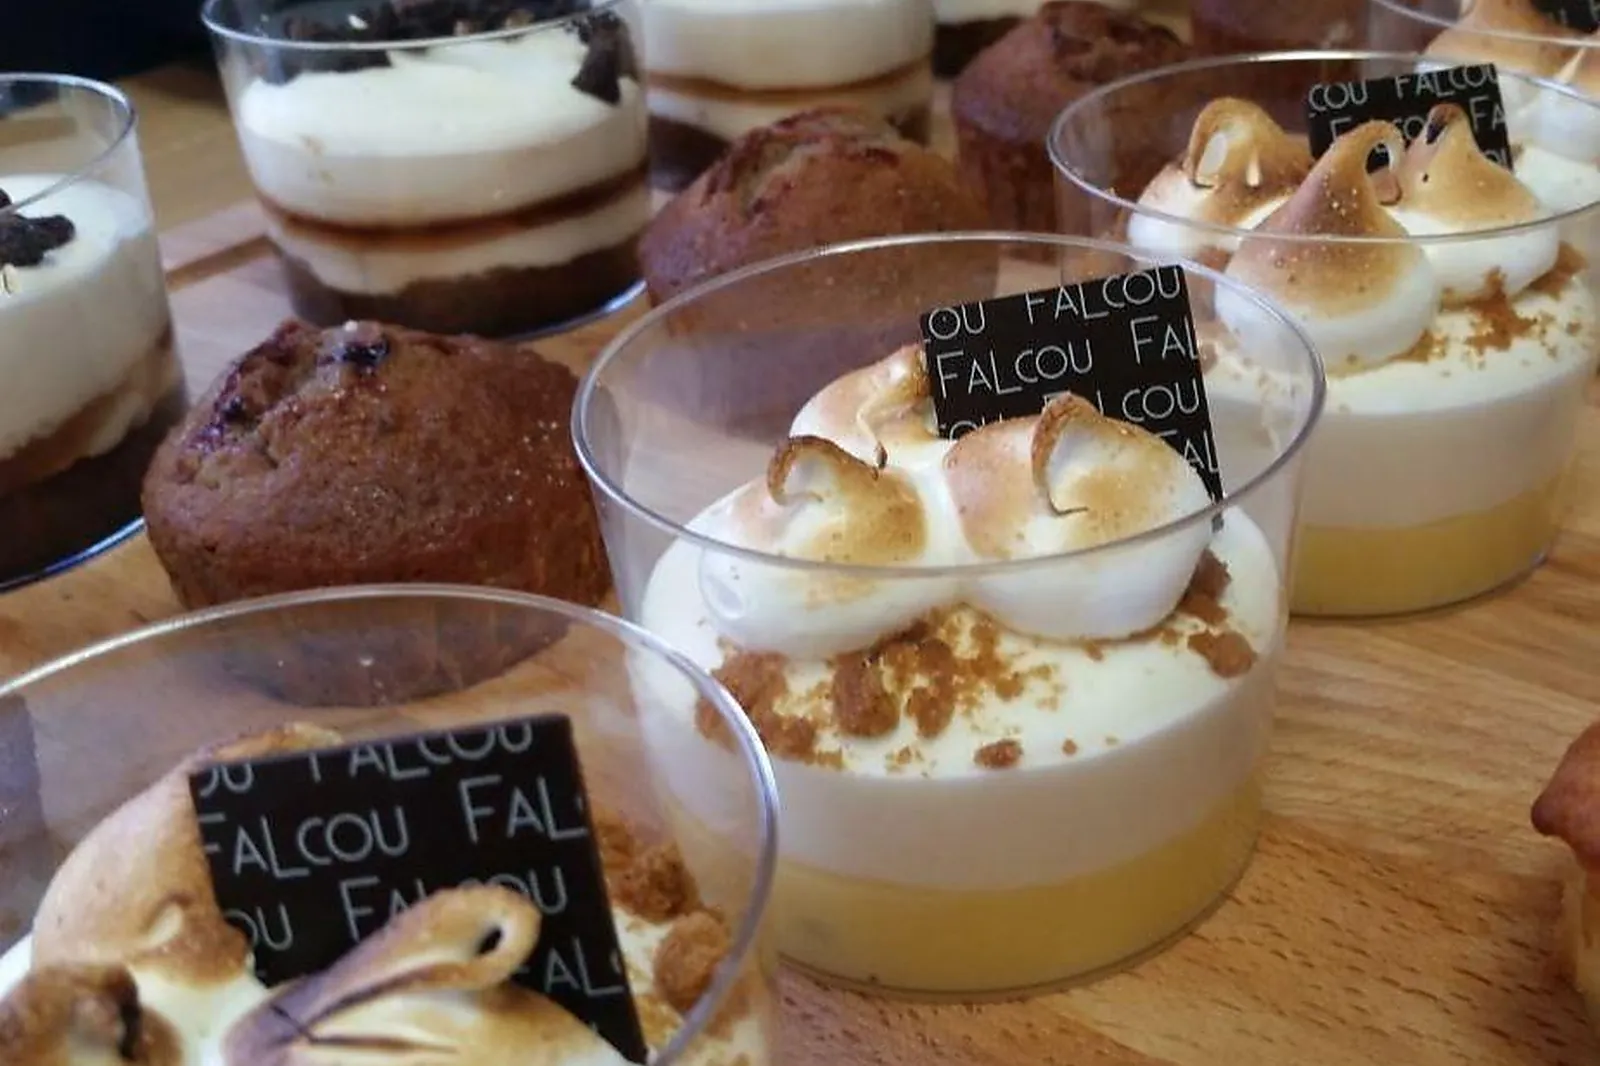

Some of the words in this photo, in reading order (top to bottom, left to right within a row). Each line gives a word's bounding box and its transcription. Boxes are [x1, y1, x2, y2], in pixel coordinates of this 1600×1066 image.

[1308, 80, 1369, 118] COU
[924, 301, 986, 342] OU
[1024, 268, 1181, 325] FALCOU
[935, 338, 1094, 399] FALCOU
[1155, 428, 1219, 473] AL
[458, 774, 589, 845] FAL
